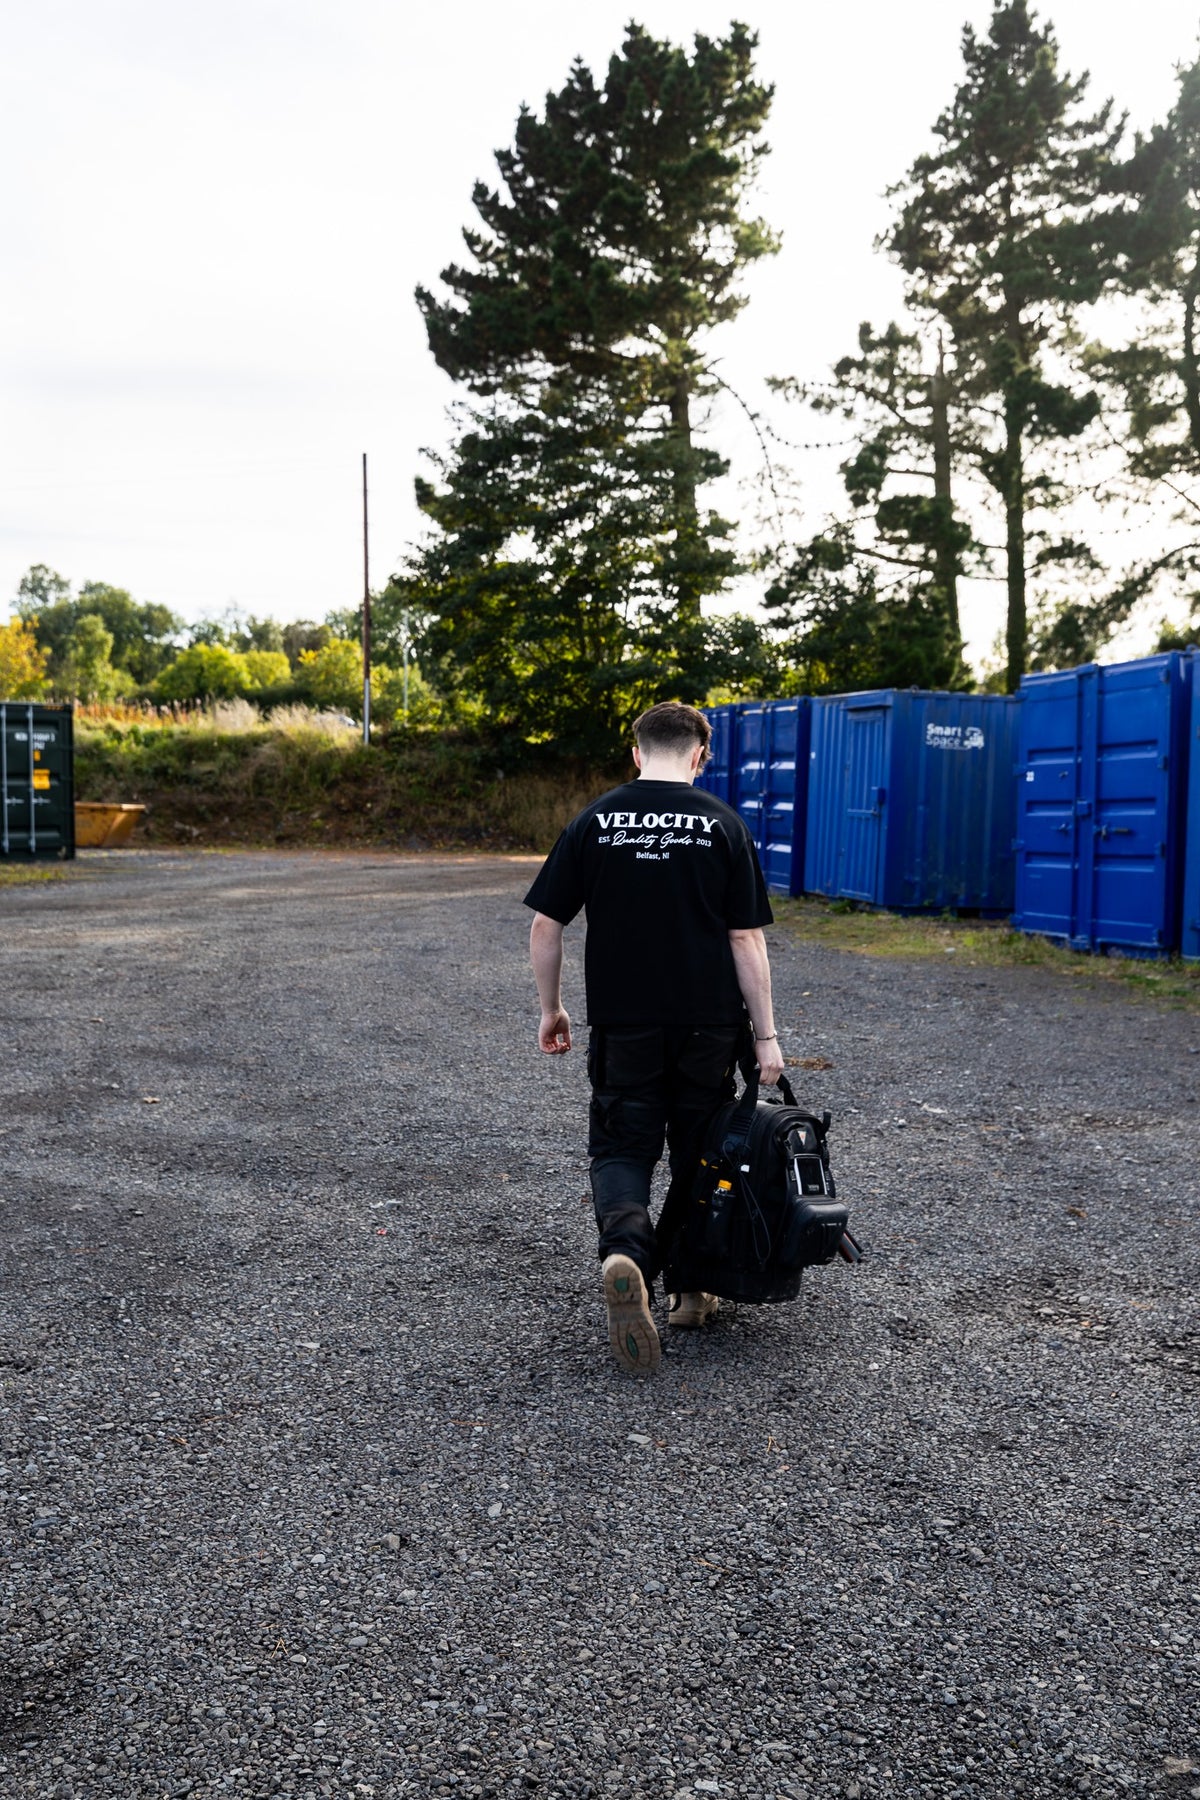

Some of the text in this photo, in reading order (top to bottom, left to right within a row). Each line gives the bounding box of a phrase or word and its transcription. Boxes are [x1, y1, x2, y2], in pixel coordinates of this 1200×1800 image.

[927, 723, 962, 737] Smart
[926, 735, 961, 748] Space
[595, 812, 719, 833] VELOCITY
[611, 830, 659, 849] Quality
[660, 832, 693, 849] Goods
[696, 838, 712, 847] 2013
[636, 851, 670, 860] Belfast, NI
